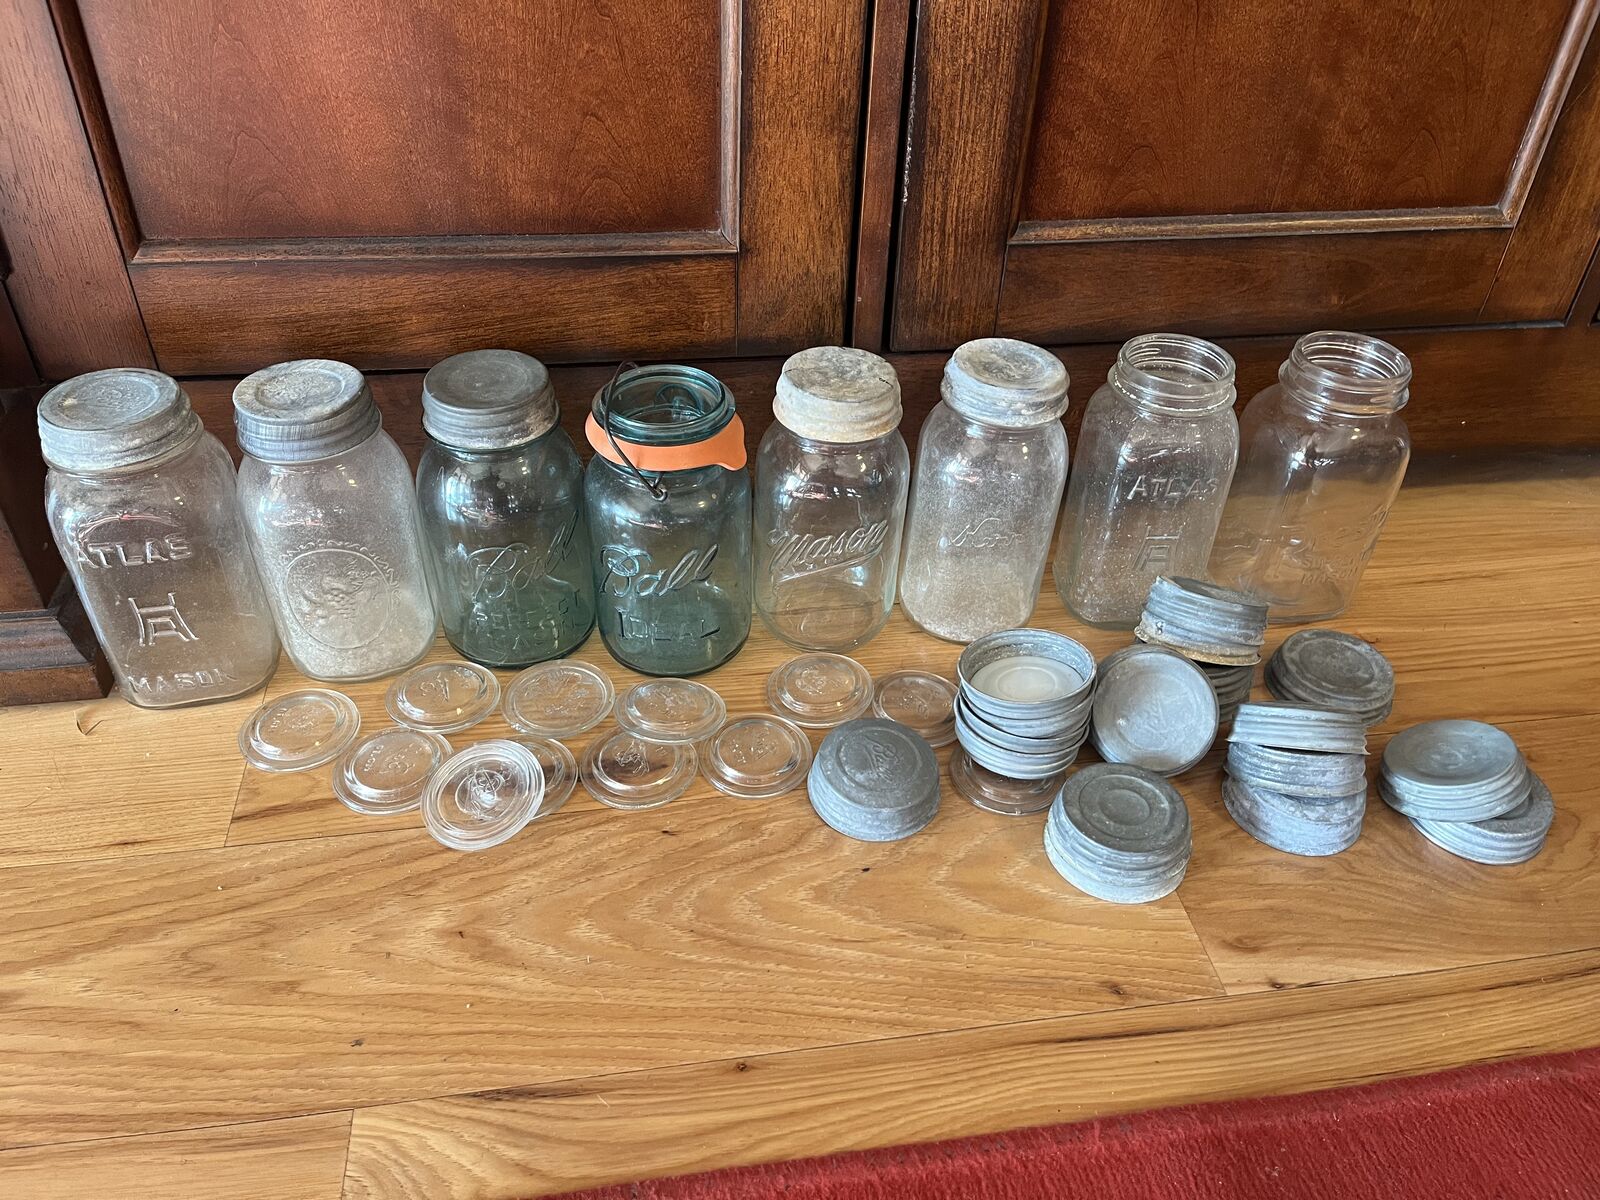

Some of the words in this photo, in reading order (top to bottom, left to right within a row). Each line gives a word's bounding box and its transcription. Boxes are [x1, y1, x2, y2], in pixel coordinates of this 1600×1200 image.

[1127, 474, 1219, 500] ATLAS
[78, 533, 193, 573] ATLAS
[768, 519, 889, 582] Mason
[600, 543, 720, 598] Ball
[615, 605, 721, 642] IDEAL
[127, 668, 238, 693] MASON
